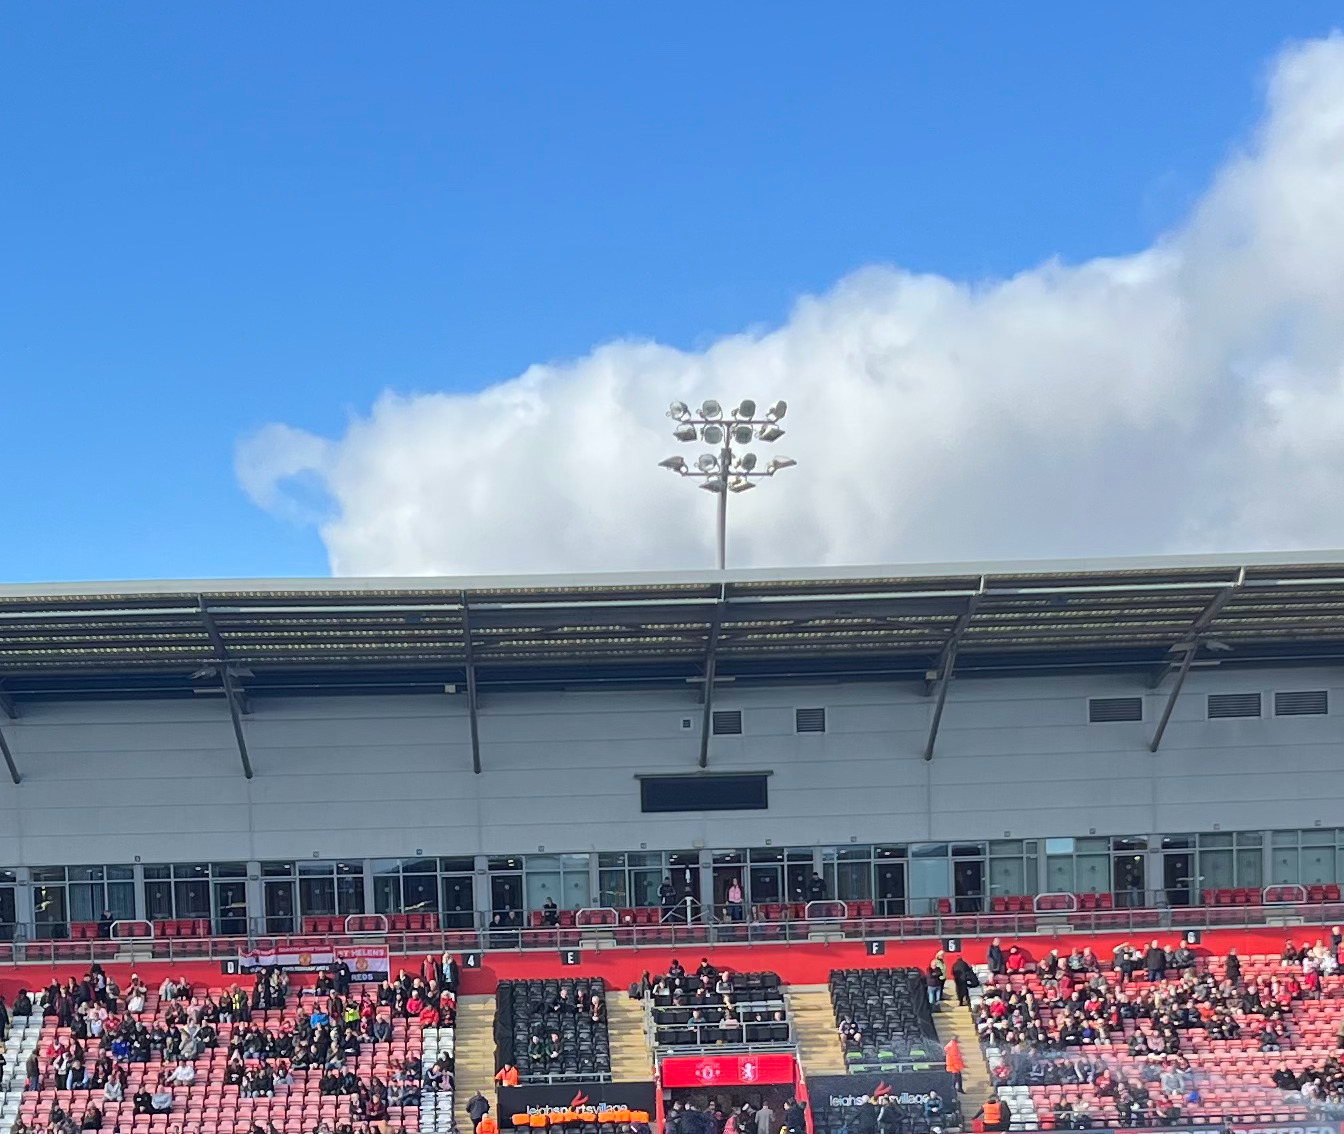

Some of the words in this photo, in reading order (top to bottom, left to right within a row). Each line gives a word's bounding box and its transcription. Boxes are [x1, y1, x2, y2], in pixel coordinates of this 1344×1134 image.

[351, 949, 384, 957] HELENS
[872, 942, 879, 954] F
[467, 955, 474, 967] 4
[567, 952, 574, 964] E
[351, 973, 374, 981] REDS
